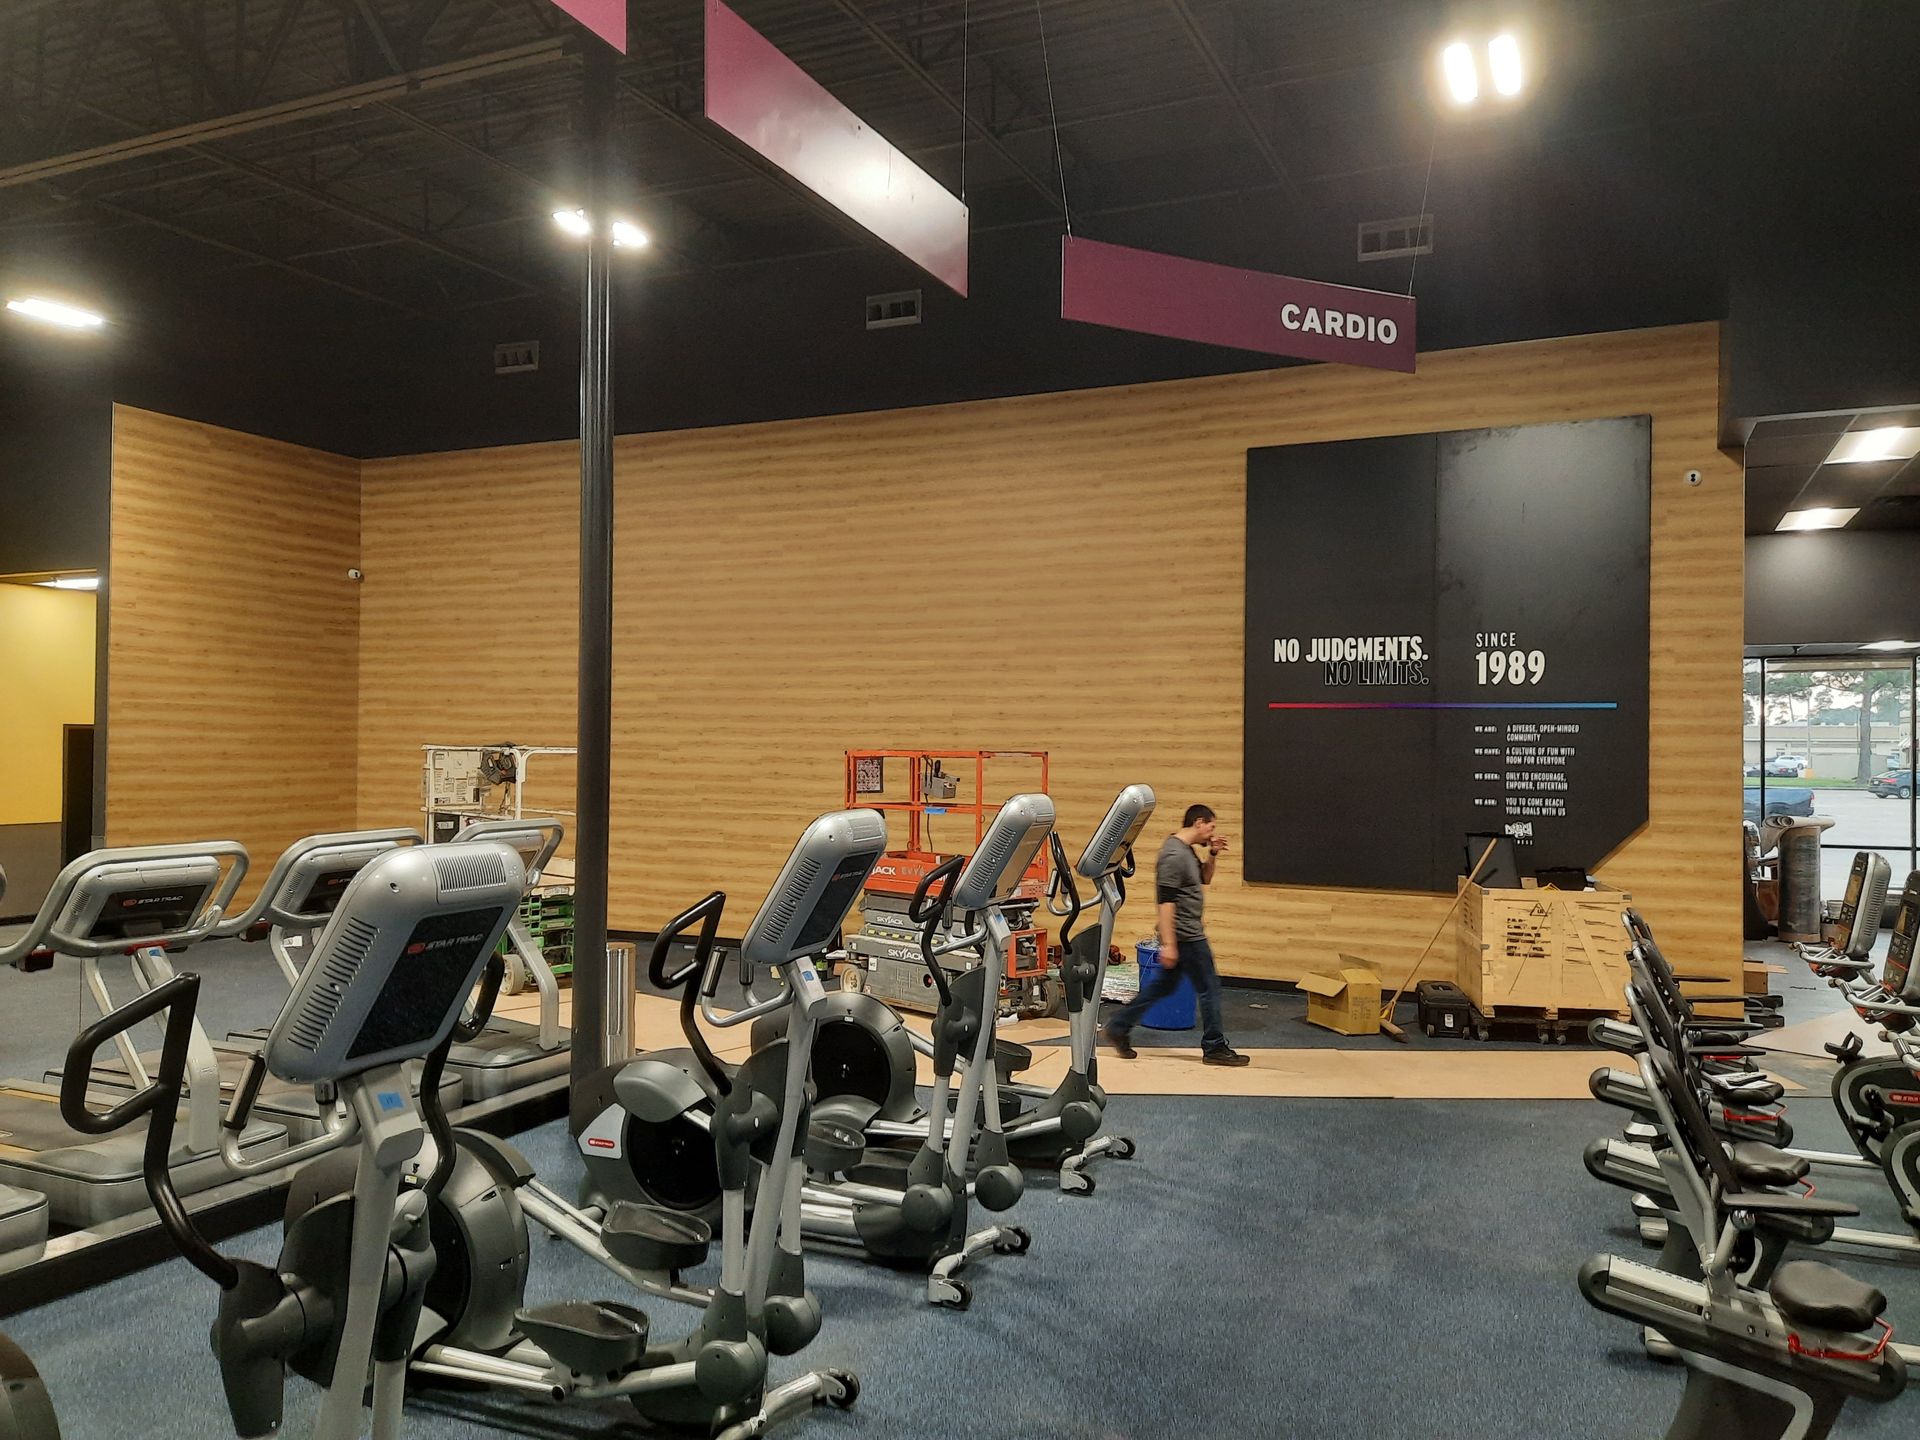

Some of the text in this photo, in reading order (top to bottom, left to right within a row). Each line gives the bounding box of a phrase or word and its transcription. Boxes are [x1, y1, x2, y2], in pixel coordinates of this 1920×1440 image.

[1281, 303, 1398, 345] CARDIO
[1475, 632, 1517, 648] SINCE
[1274, 636, 1429, 663] NO JUDGMENTS.
[1475, 650, 1546, 685] 1989
[1324, 660, 1430, 686] NO LIMITS.
[1474, 725, 1483, 733] WE
[1506, 724, 1580, 733] A DIVERSE, OPEN-MINDED
[1506, 733, 1541, 742] COMMUNITY
[1505, 747, 1575, 756] A CULTURE OF FUN WITH
[1505, 756, 1566, 765] ROOM FOR EVERYONE
[1505, 772, 1567, 782] ONLY TO ENCOURAGE,
[1505, 781, 1568, 791] EMPOWER, ENTERTAIN
[1505, 797, 1564, 807] YOU TO COME REACH
[1505, 806, 1566, 816] YOUR GOALS WITH US
[871, 866, 896, 876] JACK
[876, 915, 904, 926] SKYJACK
[888, 947, 925, 961] SKYJACK
